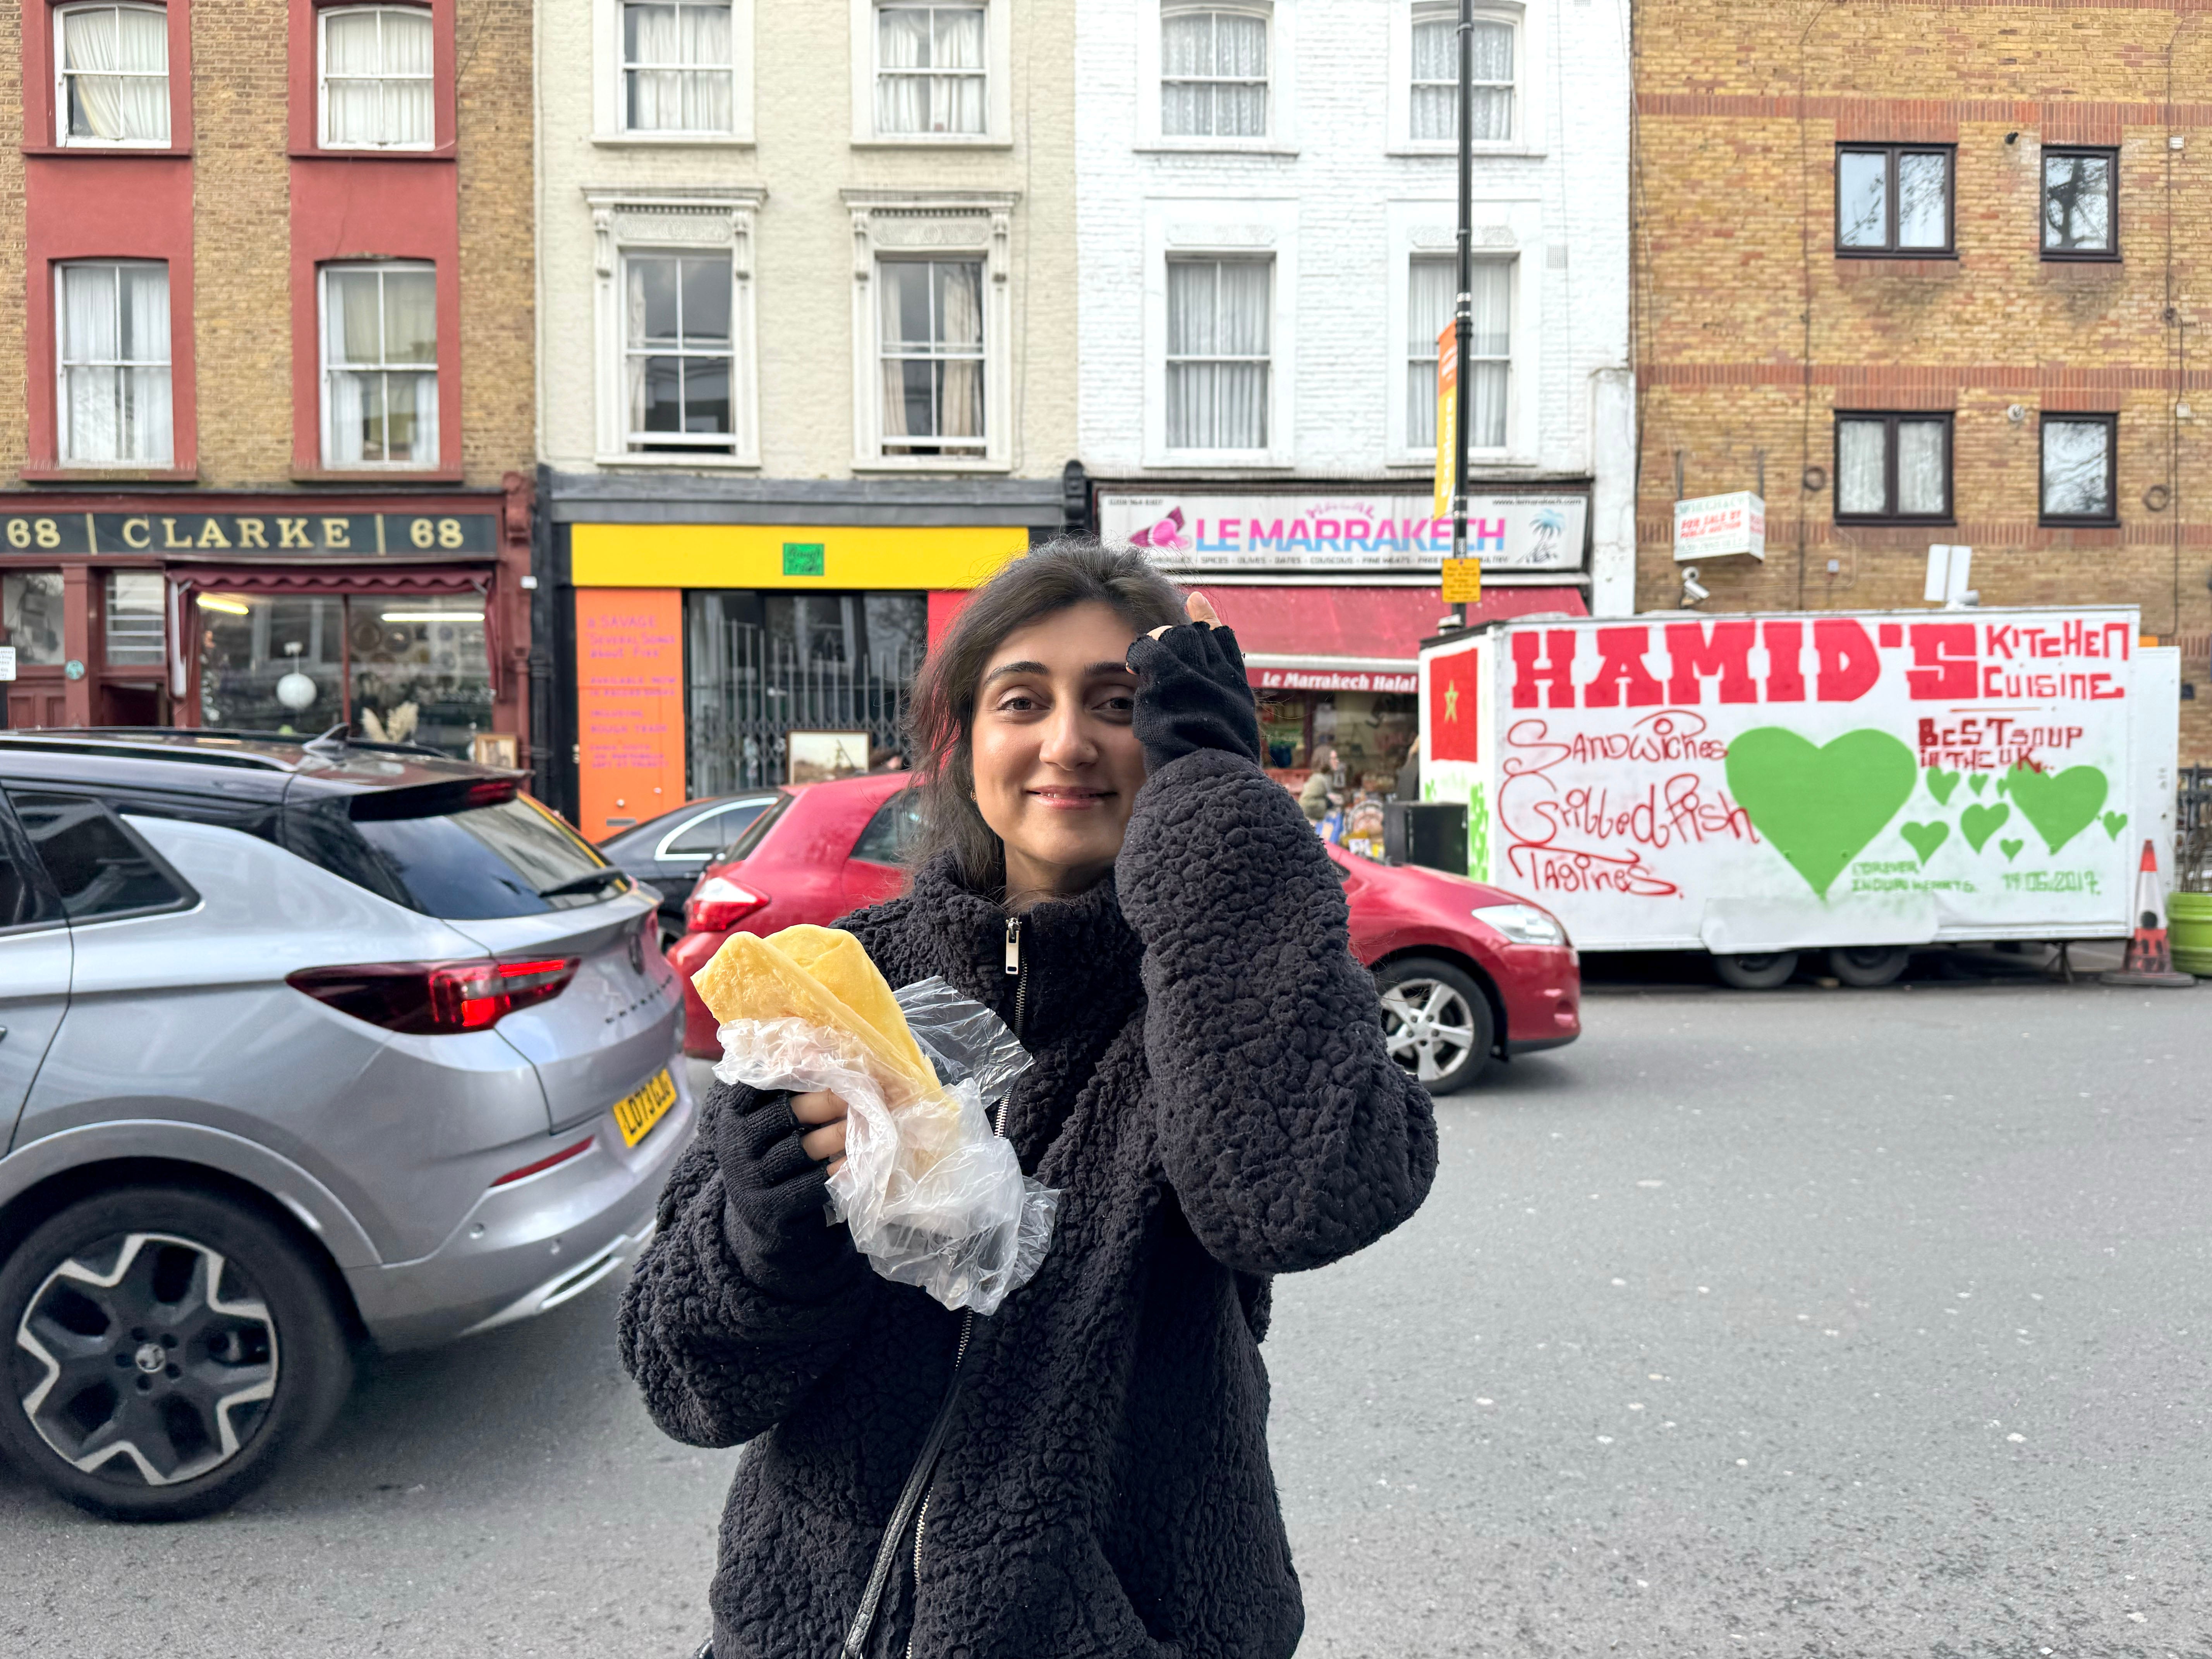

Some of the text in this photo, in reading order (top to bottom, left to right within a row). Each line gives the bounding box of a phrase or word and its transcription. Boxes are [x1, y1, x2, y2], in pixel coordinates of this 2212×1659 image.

[7, 518, 61, 548] 68
[122, 517, 350, 549] CLARKE
[409, 518, 465, 549] 68
[1195, 519, 1241, 551] LE
[601, 614, 657, 628] SAVAGE
[1512, 617, 1978, 709] HAMID'S
[1262, 671, 1417, 692] Le Marrakech Halal
